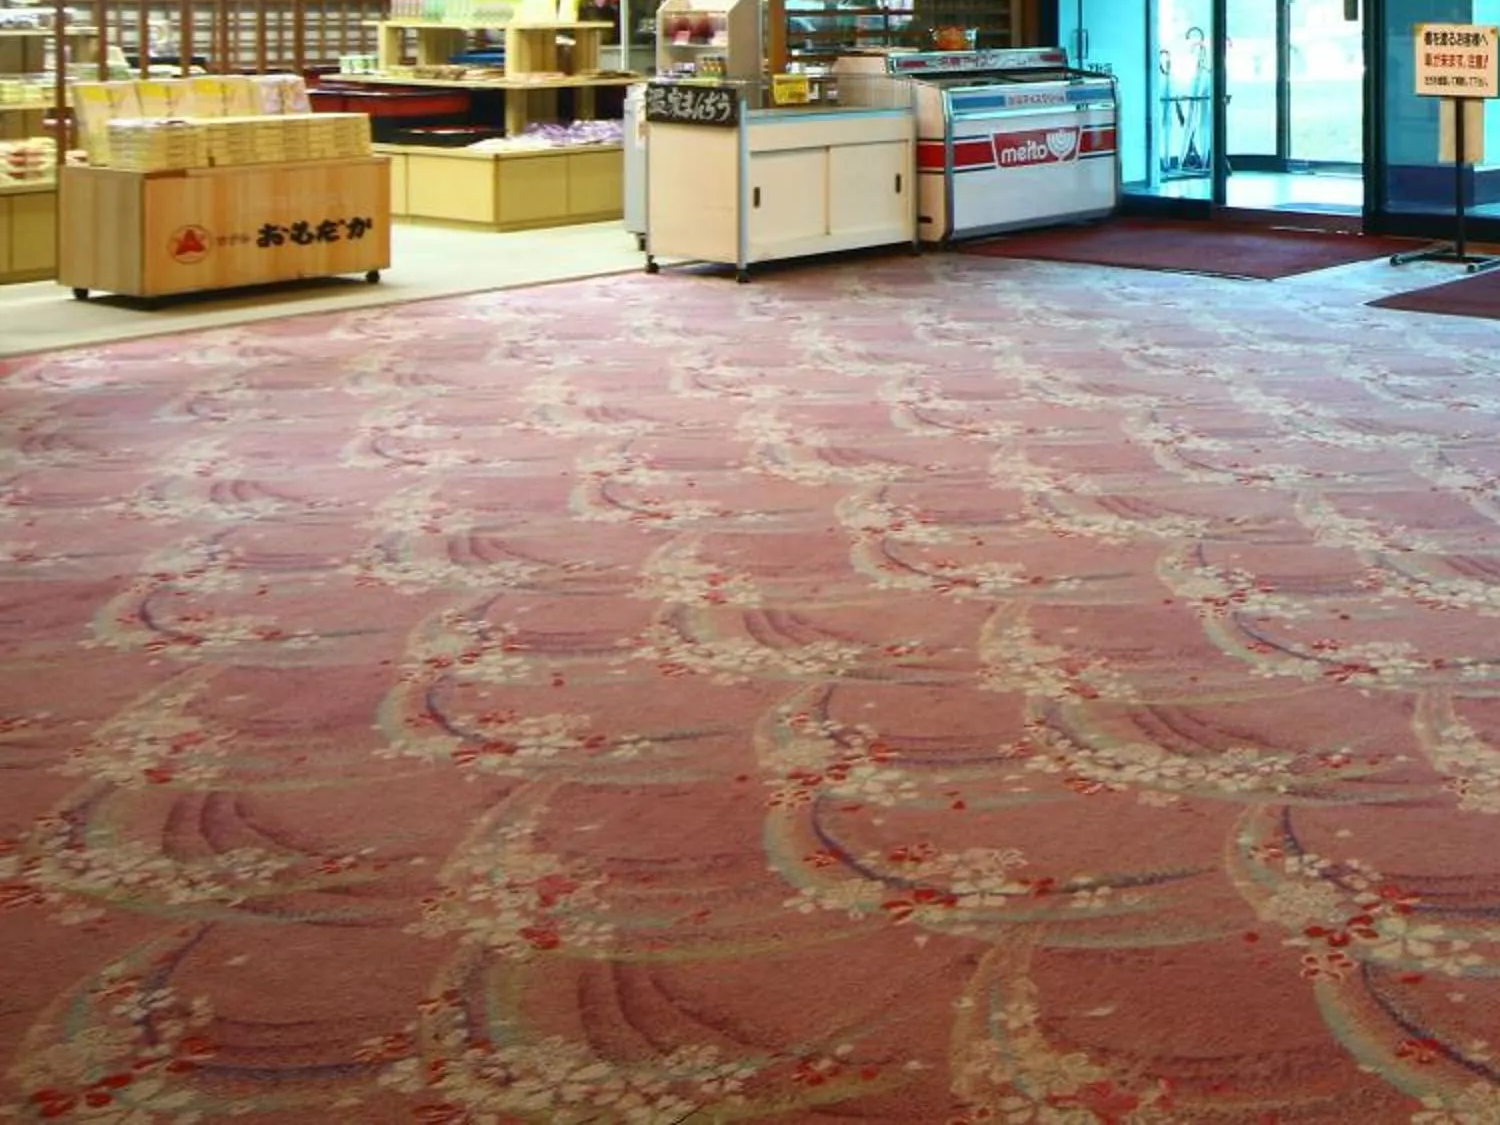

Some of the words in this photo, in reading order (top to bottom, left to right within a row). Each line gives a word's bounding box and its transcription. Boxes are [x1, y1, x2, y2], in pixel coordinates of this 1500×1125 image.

[1001, 139, 1048, 163] meito
[256, 217, 372, 248] おもだか
